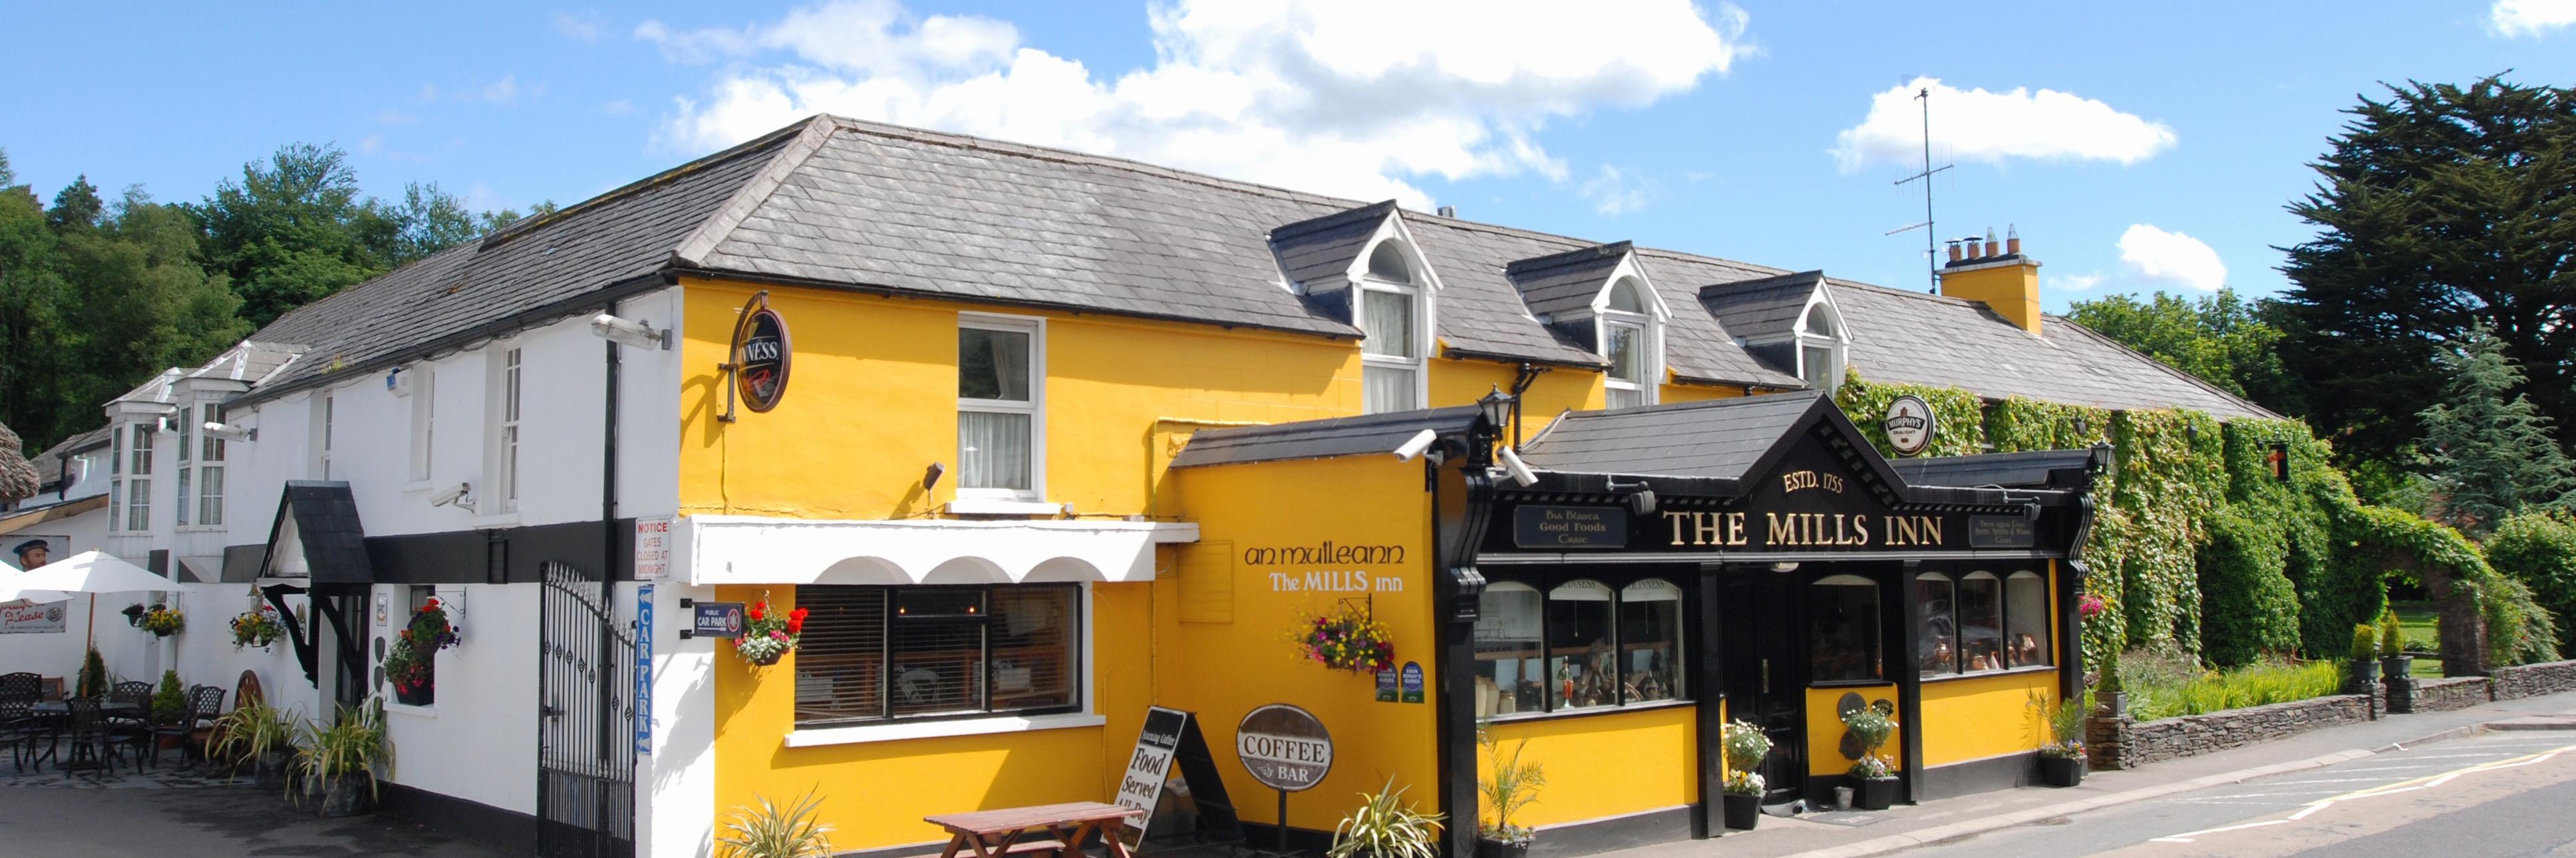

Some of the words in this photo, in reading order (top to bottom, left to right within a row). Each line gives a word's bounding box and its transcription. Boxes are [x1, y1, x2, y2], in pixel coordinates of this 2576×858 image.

[1783, 471, 1819, 493] ESTD.
[1823, 473, 1843, 494] 1755
[638, 522, 668, 533] NOTICE
[1539, 522, 1569, 531] Good
[1574, 523, 1606, 531] Foods
[1663, 510, 1747, 545] THE
[1766, 512, 1868, 545] MILLS
[1883, 515, 1943, 545] INN
[643, 537, 661, 547] GATES
[637, 551, 659, 561] CLOSED
[661, 550, 669, 560] AT
[639, 563, 665, 574] MIDNIGHT
[1269, 572, 1300, 591] The
[1303, 571, 1368, 591] MILLS
[698, 617, 710, 627] CAR
[711, 617, 726, 627] PARK
[639, 609, 650, 659] CAR
[639, 665, 649, 732] PARK
[1160, 734, 1175, 746] Coffee
[1244, 735, 1325, 763] COFFEE
[1130, 748, 1166, 776] Food
[1277, 766, 1309, 782] BAR
[1122, 775, 1157, 799] Served
